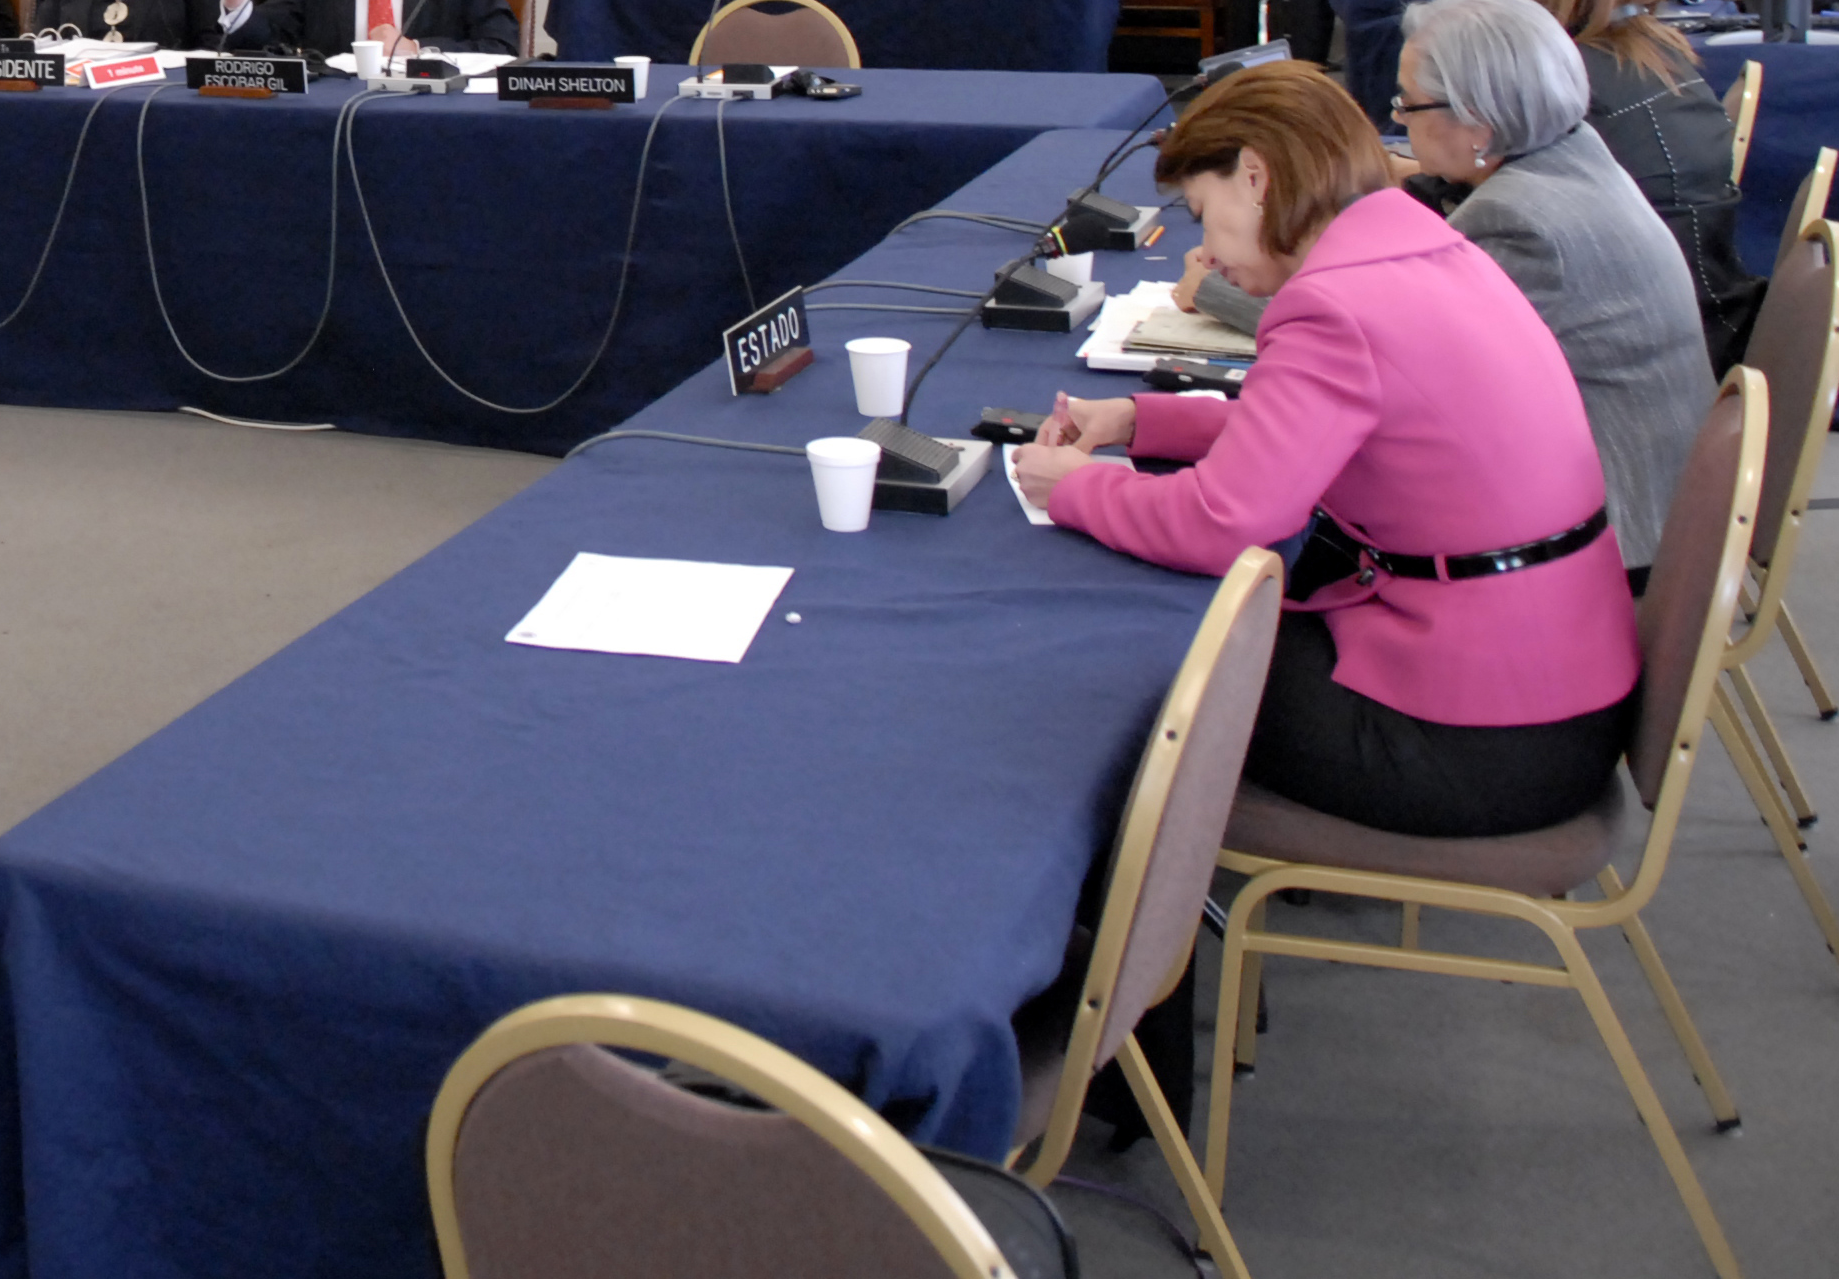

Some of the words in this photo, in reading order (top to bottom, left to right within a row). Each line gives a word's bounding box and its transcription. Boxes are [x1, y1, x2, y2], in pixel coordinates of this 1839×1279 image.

[215, 60, 274, 75] RODRIGO
[205, 74, 266, 88] ESCOBAR
[267, 77, 289, 91] GIL
[508, 76, 556, 92] DINAH
[558, 77, 626, 93] SHELTON
[737, 306, 800, 373] ESTADO
